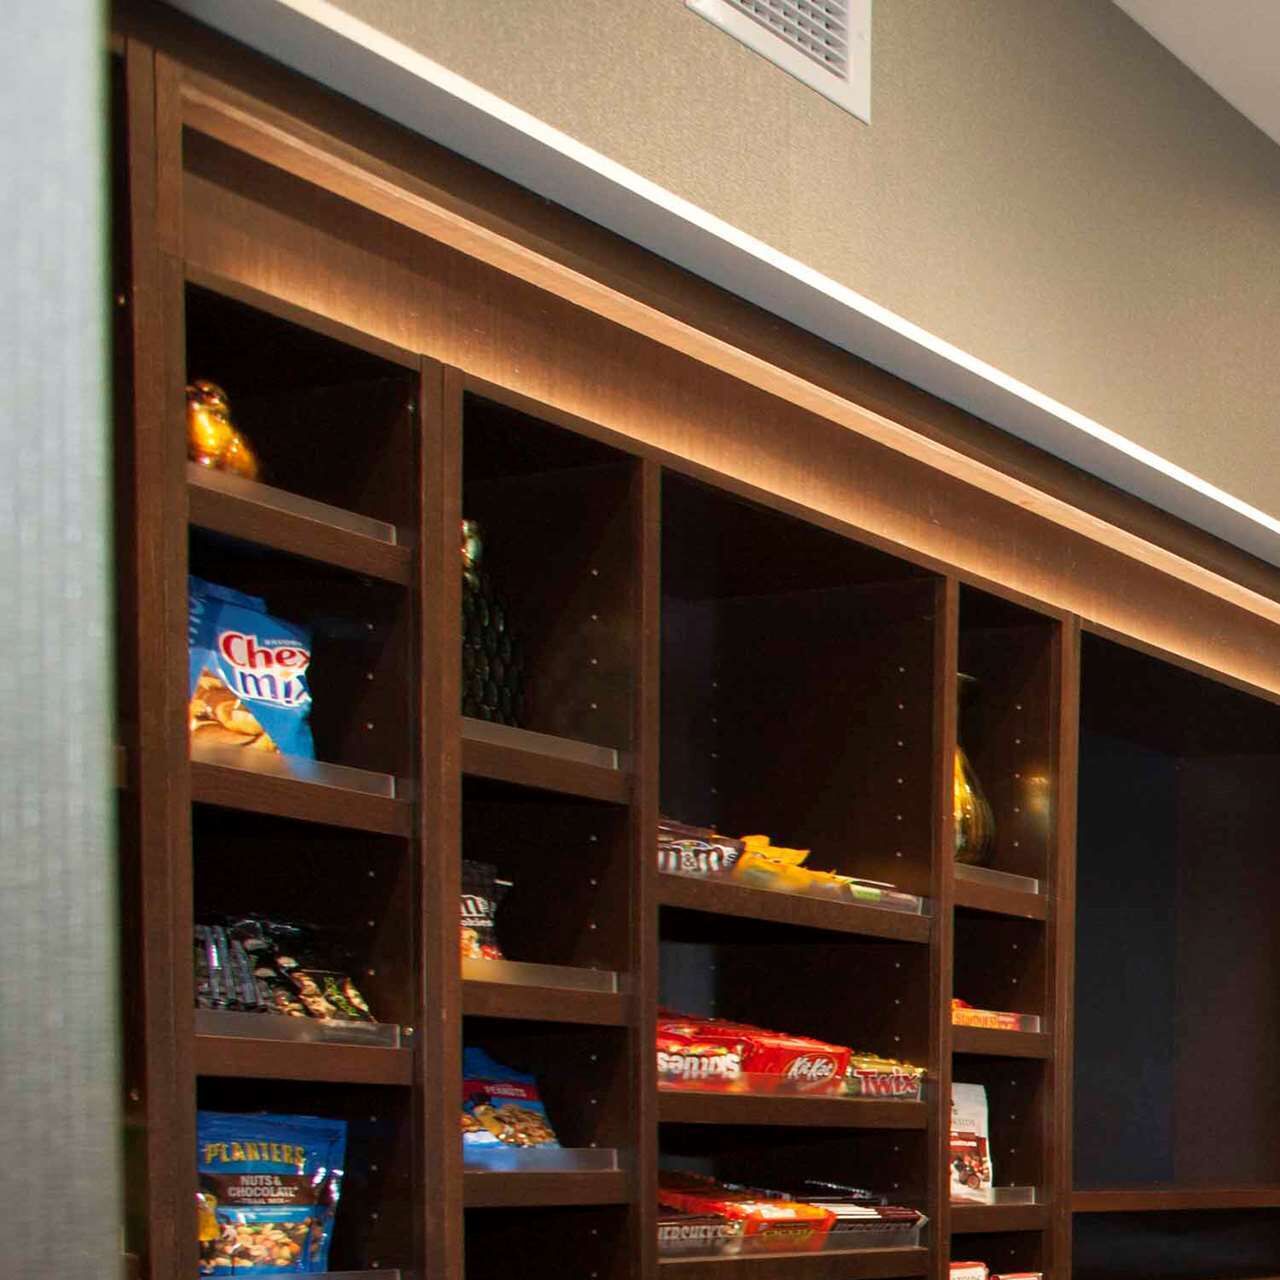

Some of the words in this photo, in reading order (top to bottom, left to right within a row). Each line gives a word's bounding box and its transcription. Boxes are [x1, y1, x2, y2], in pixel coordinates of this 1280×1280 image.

[203, 1142, 305, 1165] PLANTERS
[240, 1175, 272, 1186] NUTS
[226, 1186, 297, 1198] CHOCOLATE
